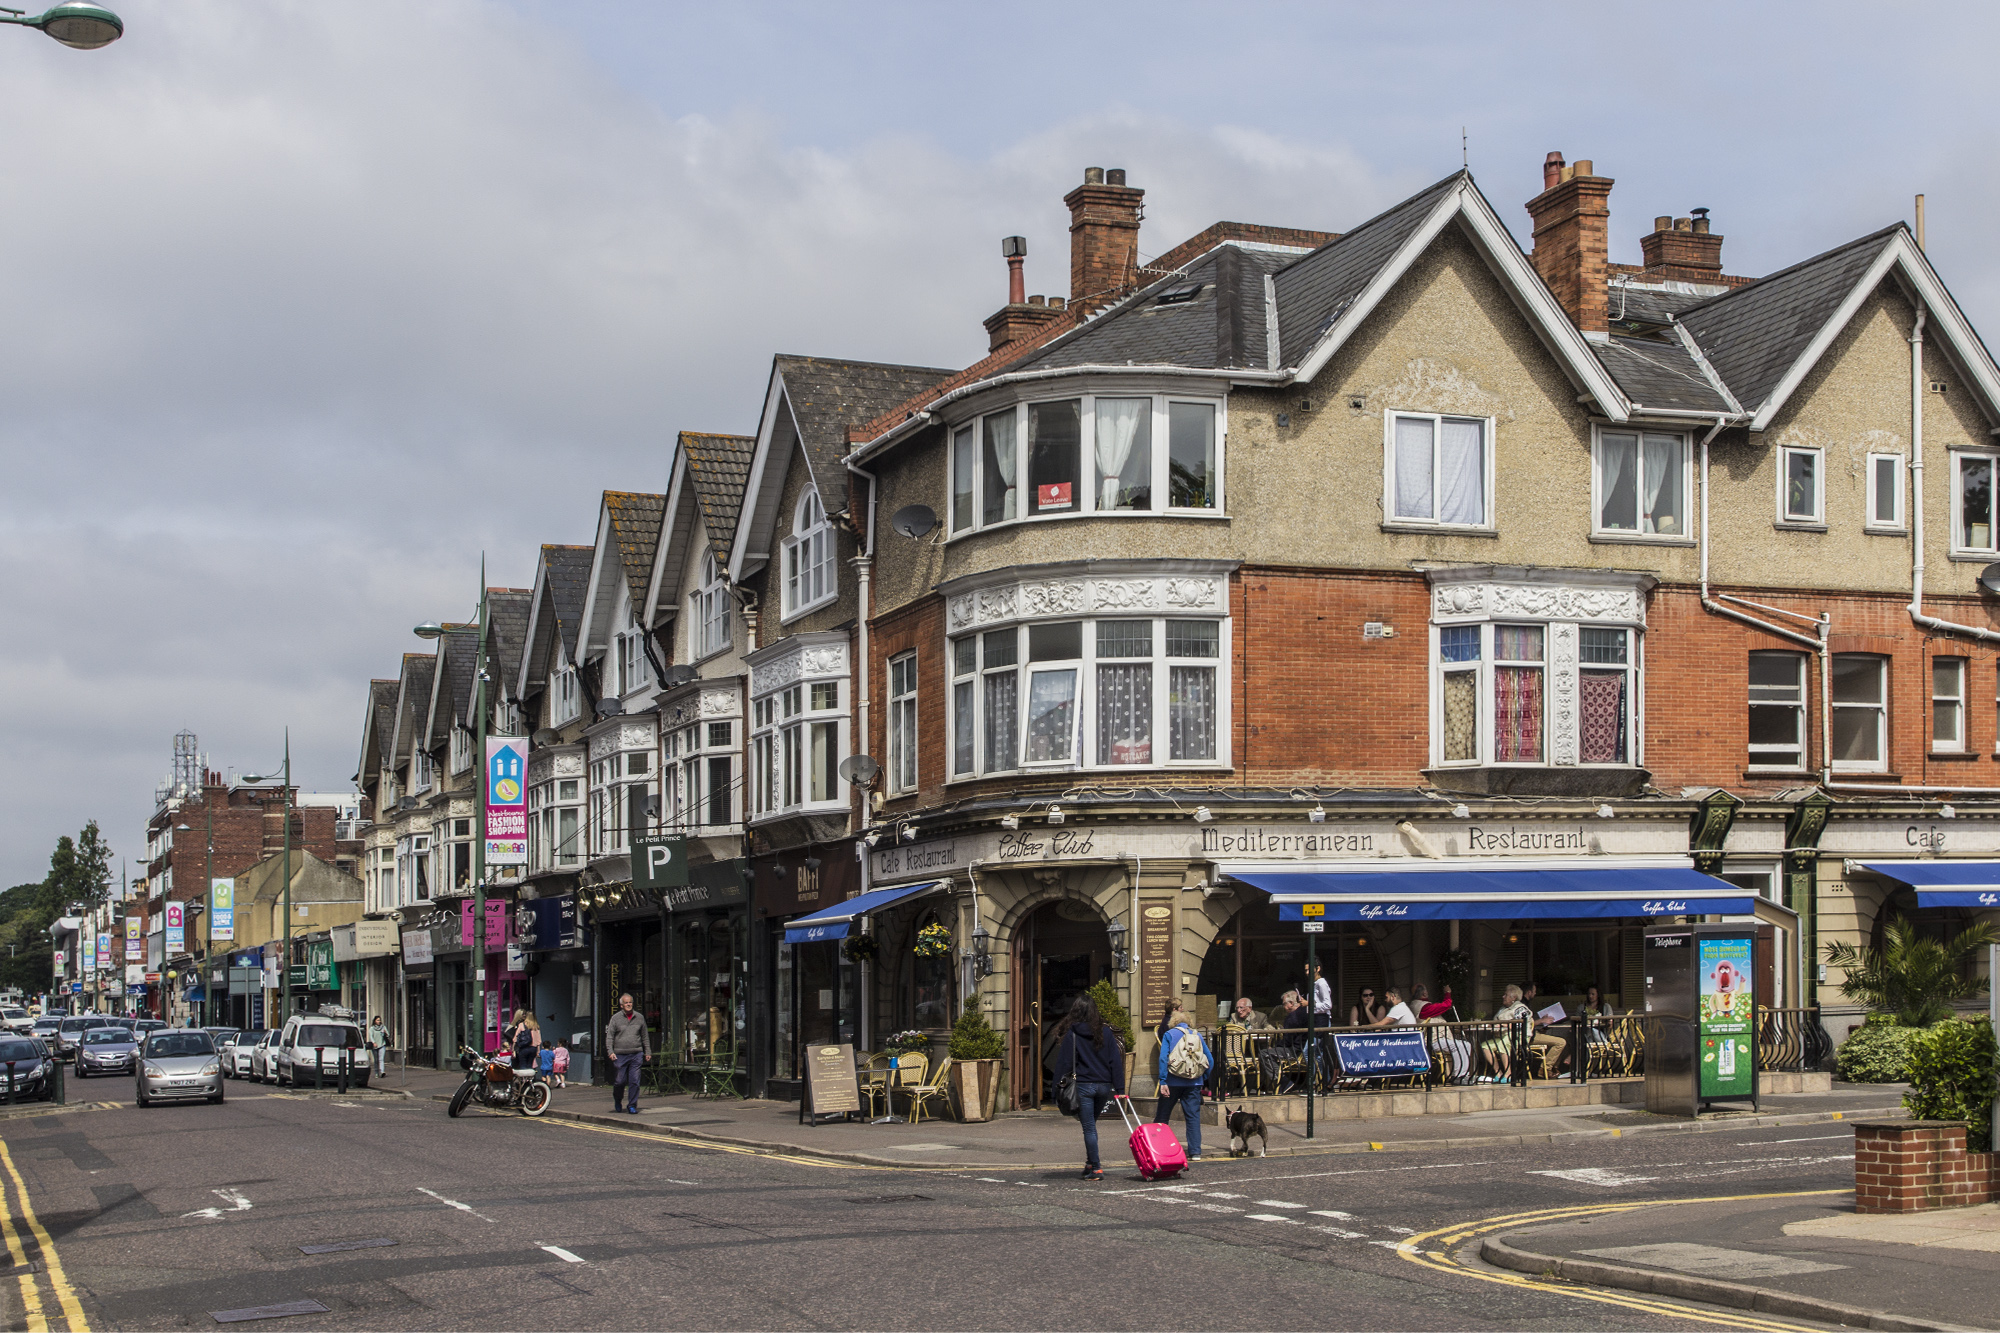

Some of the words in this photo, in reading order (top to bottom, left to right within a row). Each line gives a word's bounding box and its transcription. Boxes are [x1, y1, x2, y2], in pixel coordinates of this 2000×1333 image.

[488, 816, 525, 828] FASHION
[488, 826, 525, 836] SHOPPING
[1469, 826, 1586, 850] Restaurant
[1906, 826, 1946, 847] Cafe
[999, 832, 1044, 859] Coffee
[1052, 829, 1095, 855] Club
[1201, 828, 1374, 852] Mediterranean
[648, 846, 672, 880] P
[881, 852, 900, 874] Cafe
[906, 840, 957, 870] Restaurant
[674, 885, 690, 904] Petit
[688, 884, 710, 901] Prince
[1978, 892, 1998, 906] Coffee
[1359, 904, 1384, 918] Coffee
[1386, 904, 1408, 916] Club
[1642, 901, 1665, 914] Coffee
[1666, 900, 1686, 910] Club
[1654, 937, 1682, 948] Telephone
[186, 974, 198, 983] M
[1340, 1040, 1361, 1050] Coffee
[1362, 1039, 1379, 1047] Club
[1382, 1038, 1420, 1047] Westbourne
[1346, 1061, 1367, 1072] Coffee
[1368, 1060, 1385, 1068] Club
[1408, 1059, 1426, 1068] Quay
